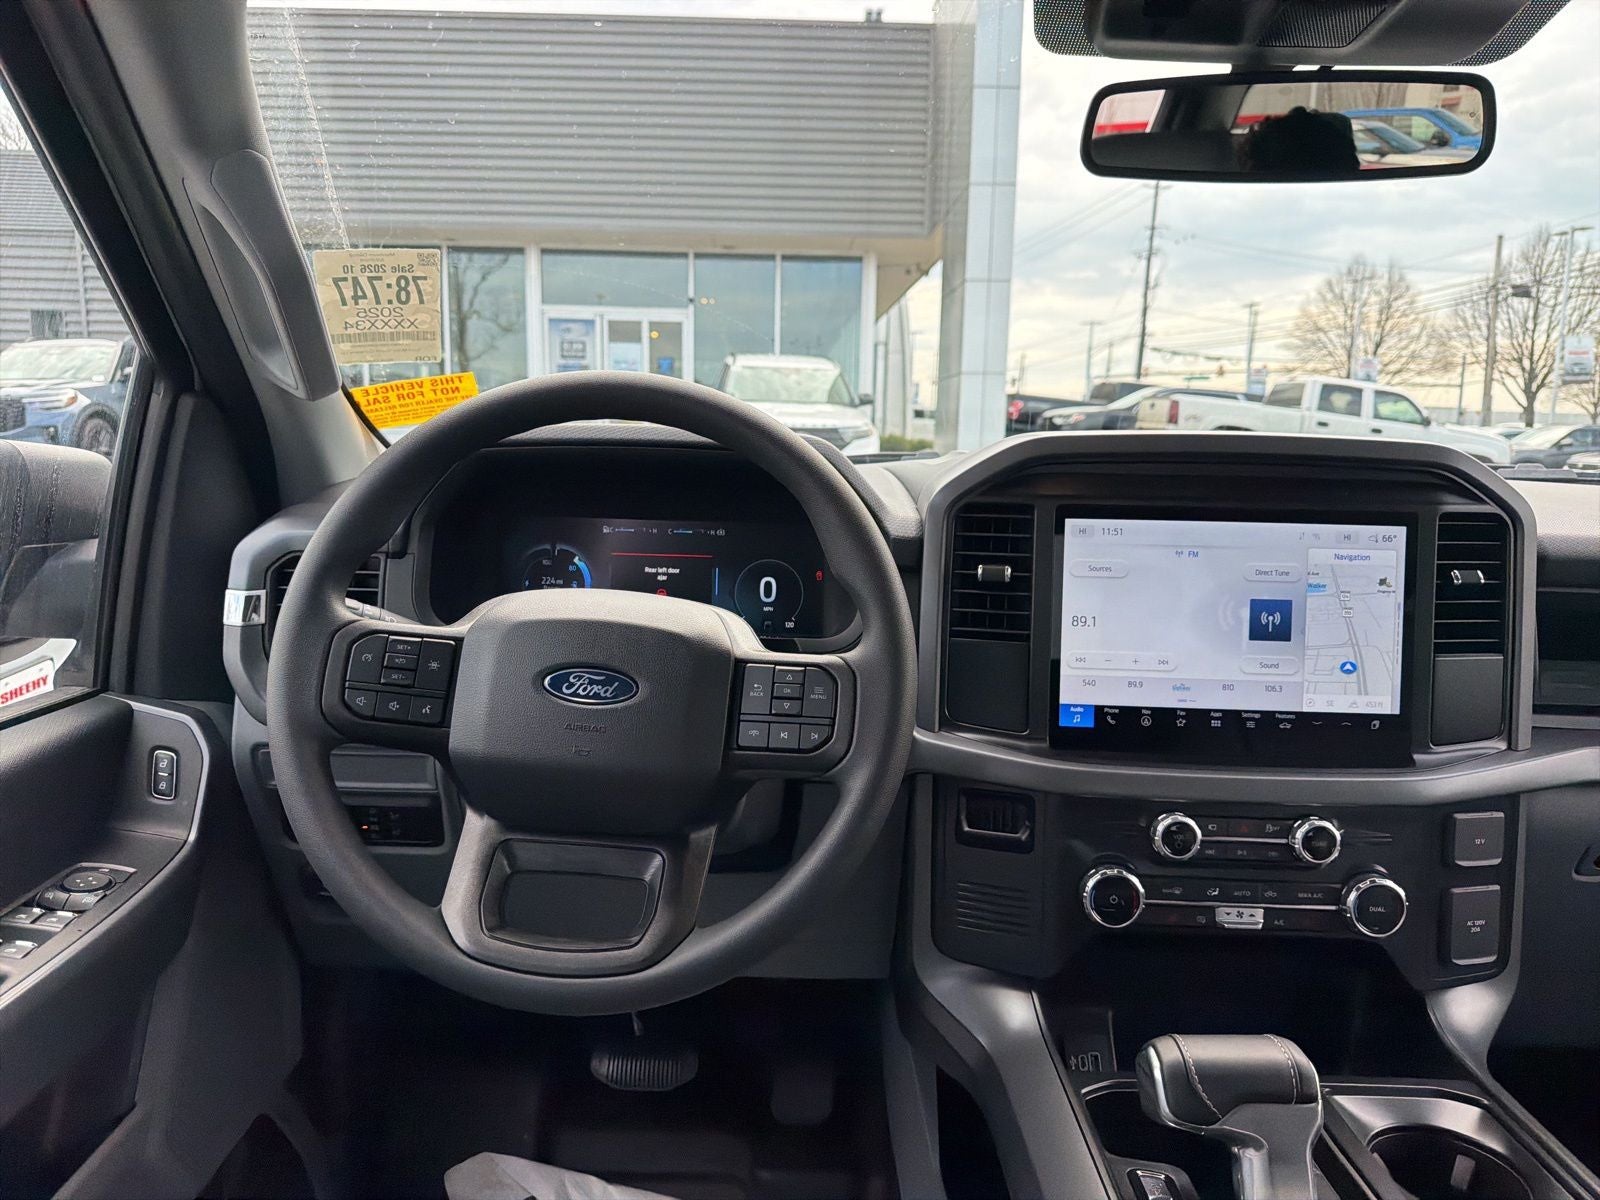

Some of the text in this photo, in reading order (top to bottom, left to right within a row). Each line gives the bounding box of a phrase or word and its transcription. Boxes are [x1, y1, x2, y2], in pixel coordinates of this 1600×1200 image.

[1101, 528, 1123, 536] 11:51
[1334, 553, 1371, 562] Navigation
[1088, 565, 1112, 573] Sources
[1255, 569, 1290, 577] Direct Tune
[541, 577, 555, 585] 224
[759, 576, 777, 603] 0
[1071, 615, 1096, 627] 89.1
[562, 672, 619, 698] Ford
[1082, 679, 1096, 687] 540
[0, 674, 49, 704] SHEEHY
[564, 723, 608, 733] AIRBAG
